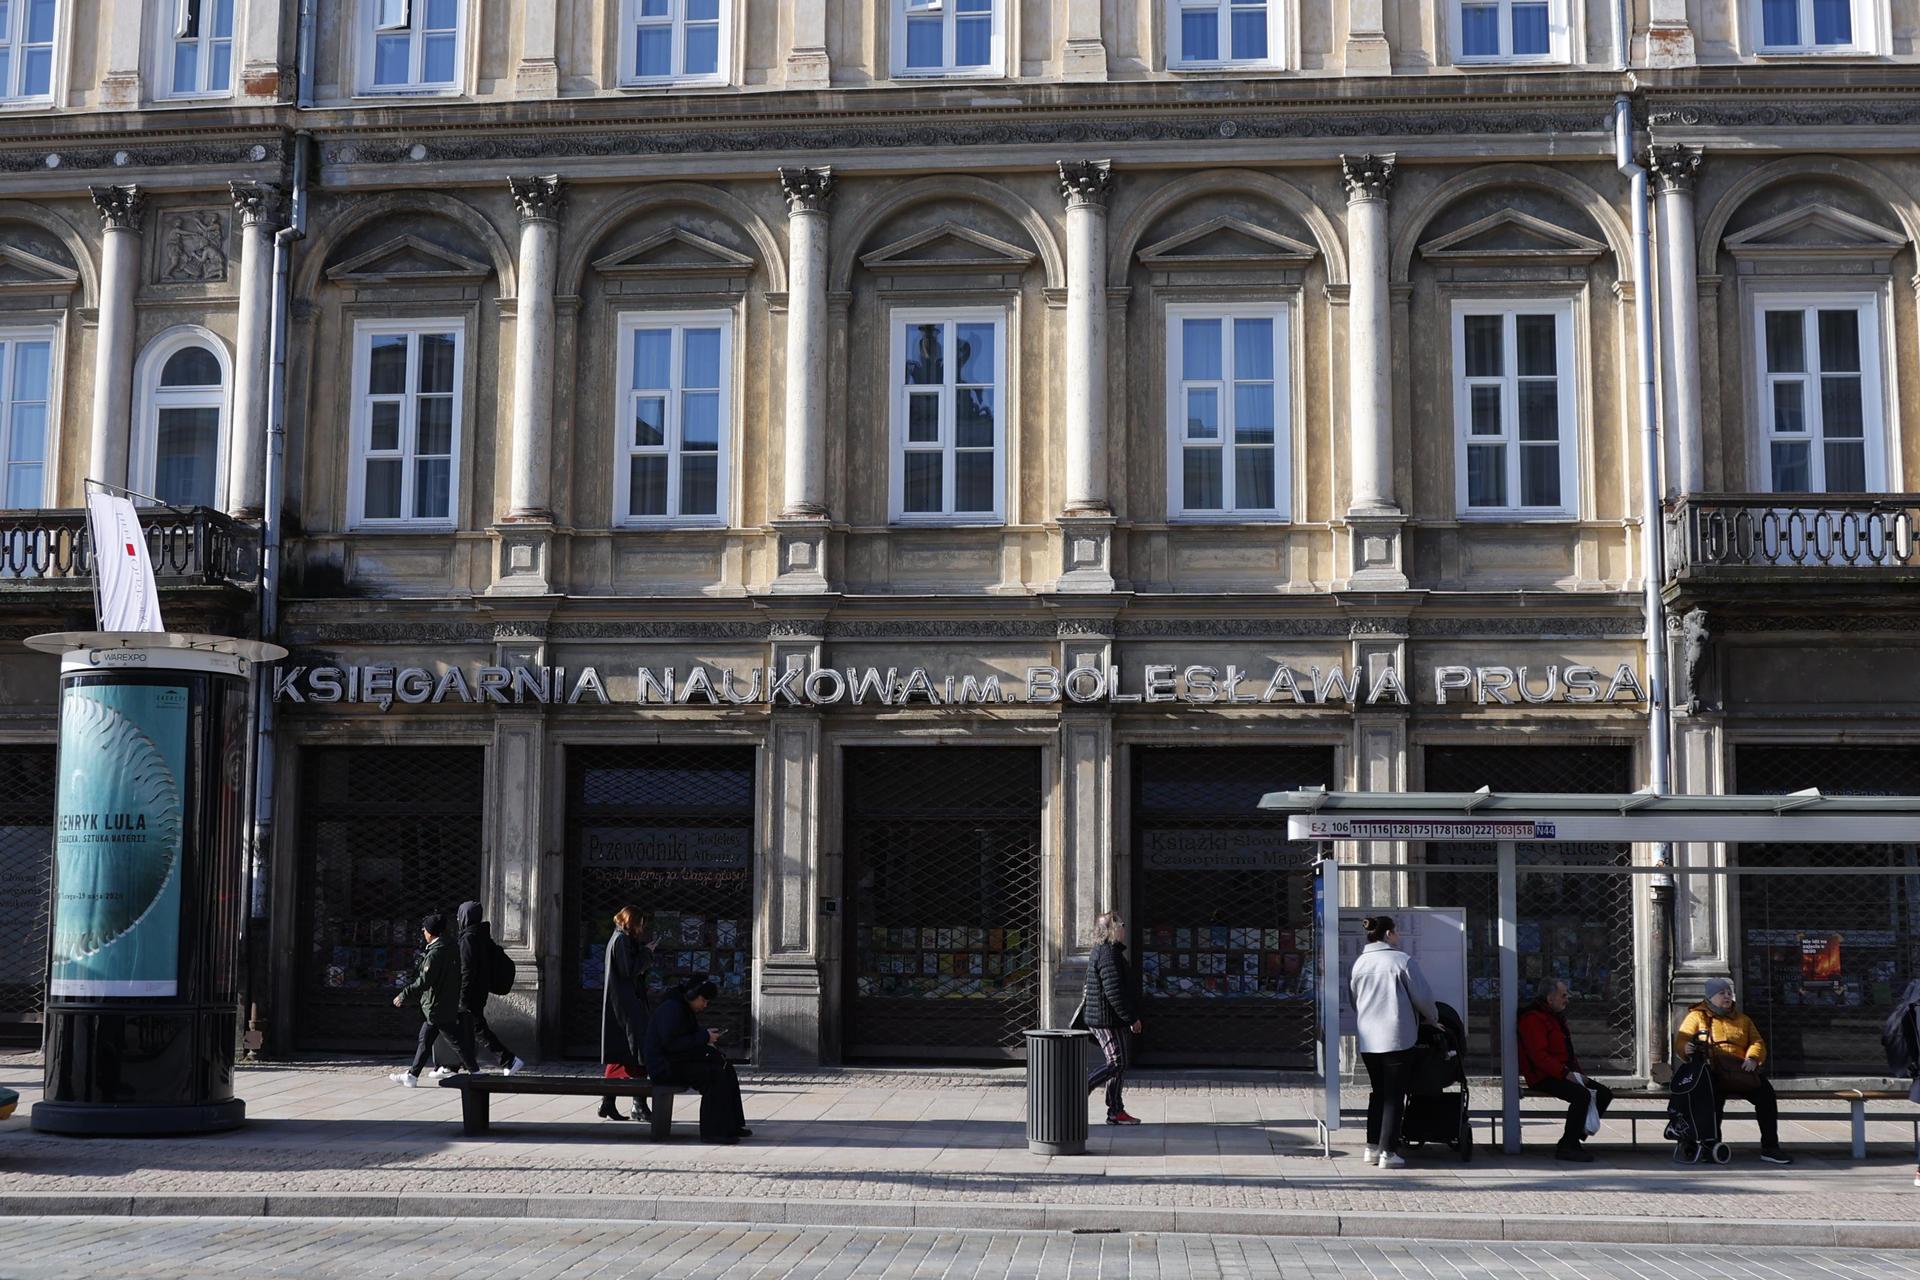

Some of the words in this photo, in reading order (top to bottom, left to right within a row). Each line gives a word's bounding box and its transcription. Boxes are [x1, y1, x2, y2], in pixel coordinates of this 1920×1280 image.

[104, 653, 147, 662] WAREXPO
[274, 665, 609, 711] KSIĘGARNIA
[638, 666, 941, 705] NAUKOWA
[1026, 665, 1411, 705] BOLESŁAWA
[1434, 664, 1648, 705] PRUSA
[105, 813, 146, 831] LULA
[1311, 823, 1327, 832] E-2
[1332, 822, 1349, 832] 106
[1353, 825, 1368, 834] 111
[1372, 825, 1389, 834] 116
[1393, 825, 1410, 834] 128
[1413, 825, 1430, 834] 175
[1434, 826, 1451, 835] 178
[1455, 826, 1472, 835] 180
[1475, 826, 1492, 835] 222
[1496, 826, 1513, 835] 503
[1516, 826, 1533, 835] 518
[1536, 827, 1555, 836] N44
[84, 834, 109, 843] SZTUKA
[588, 833, 688, 861] Przewodniki
